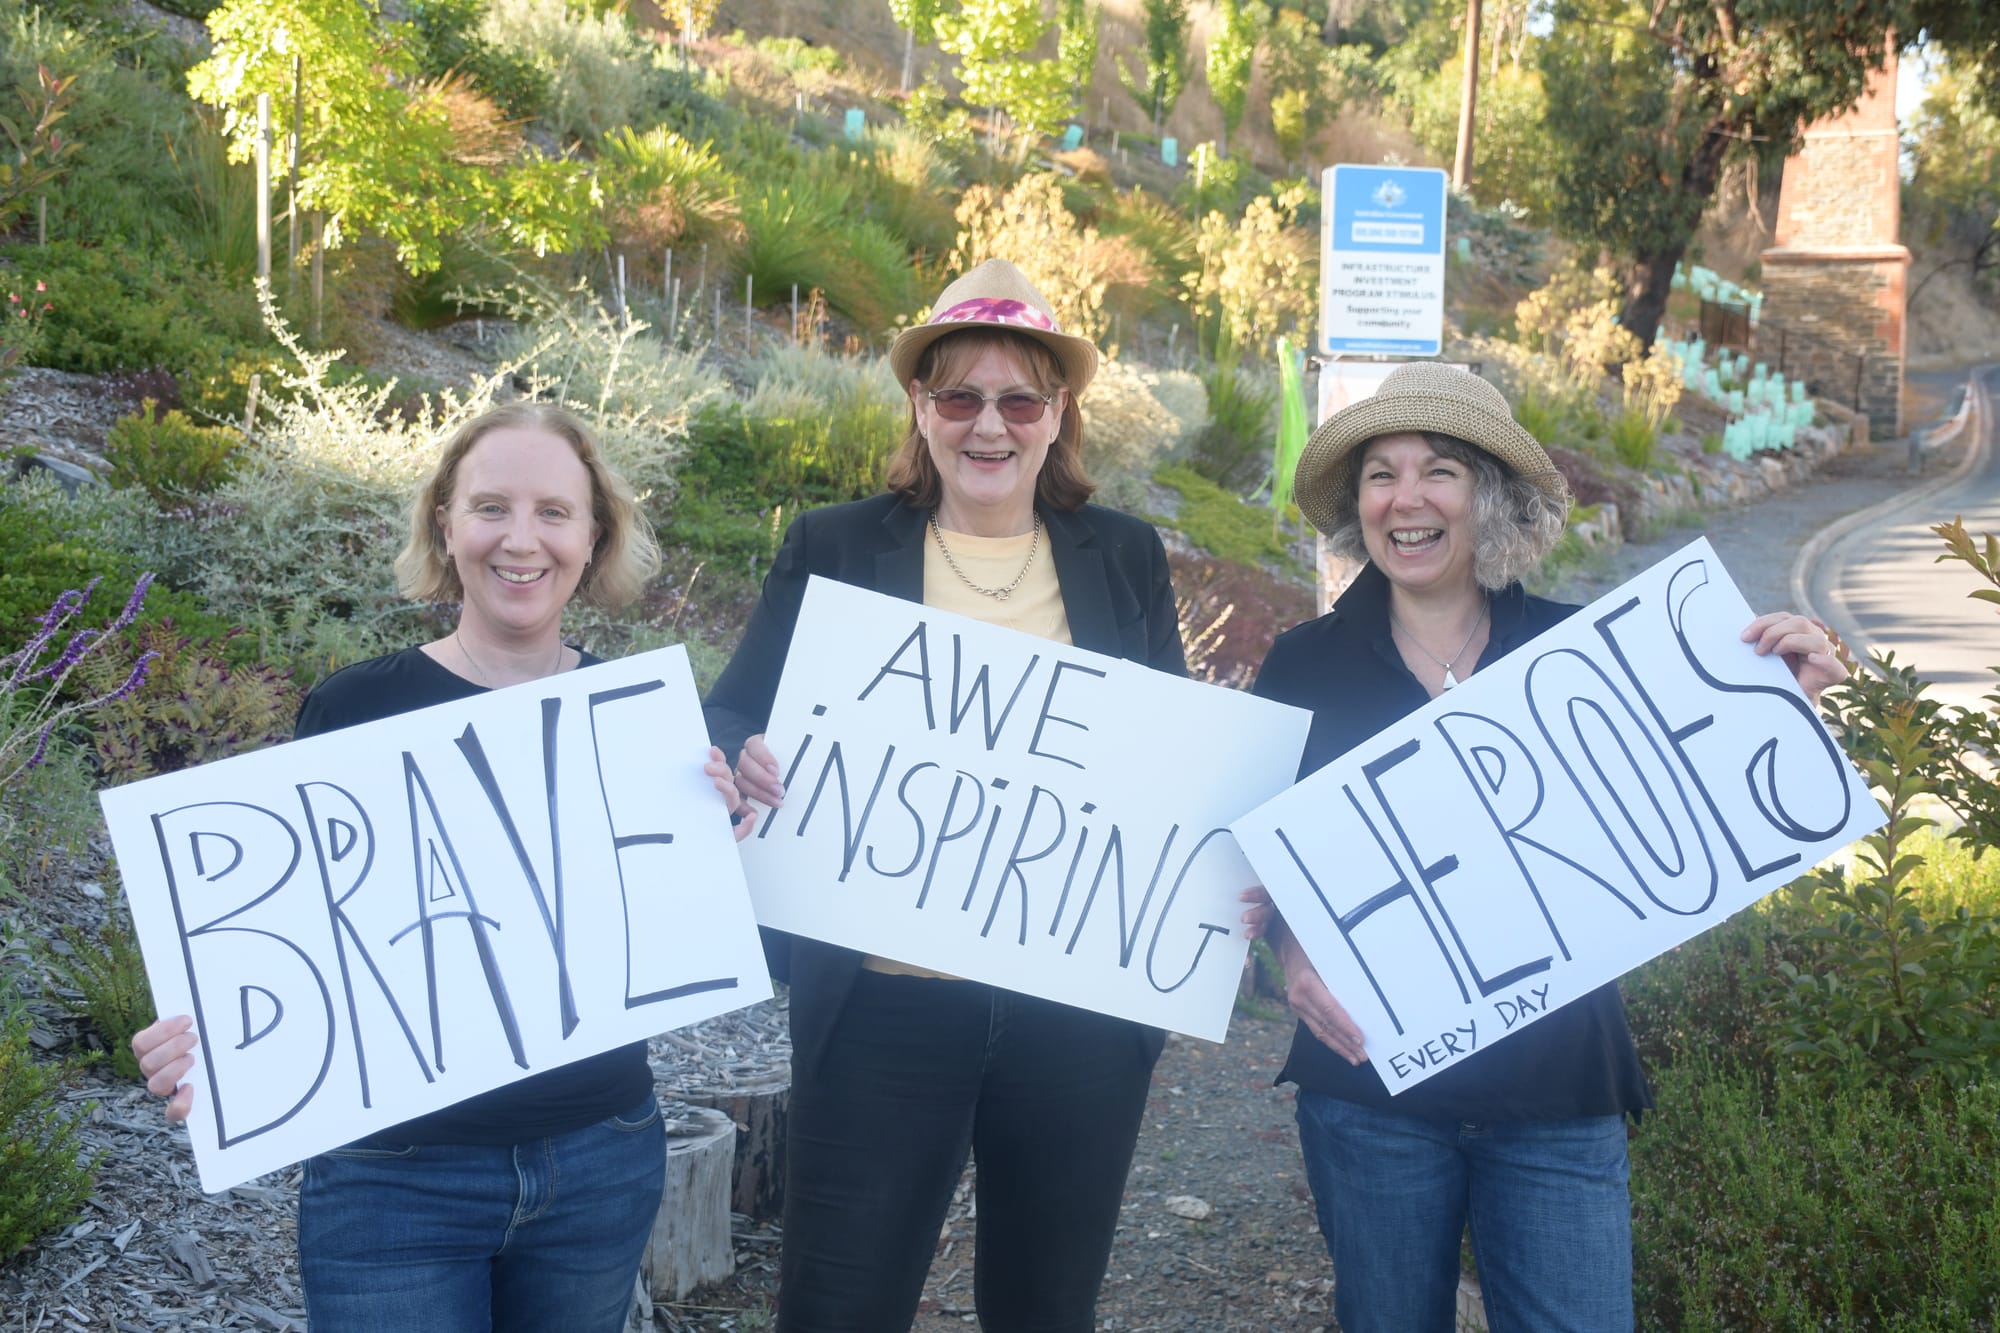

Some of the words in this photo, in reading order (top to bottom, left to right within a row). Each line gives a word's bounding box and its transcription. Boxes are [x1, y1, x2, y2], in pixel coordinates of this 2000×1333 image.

[1332, 289, 1382, 297] PROGRAM
[1341, 263, 1431, 273] INFRASTRUCTURE
[1346, 305, 1399, 315] Supporting
[857, 621, 1107, 770] AWE
[1275, 559, 1852, 1036] HEROES
[150, 679, 739, 1151] BRAVE
[1389, 1019, 1476, 1079] EVERY
[1494, 983, 1549, 1030] DAY
